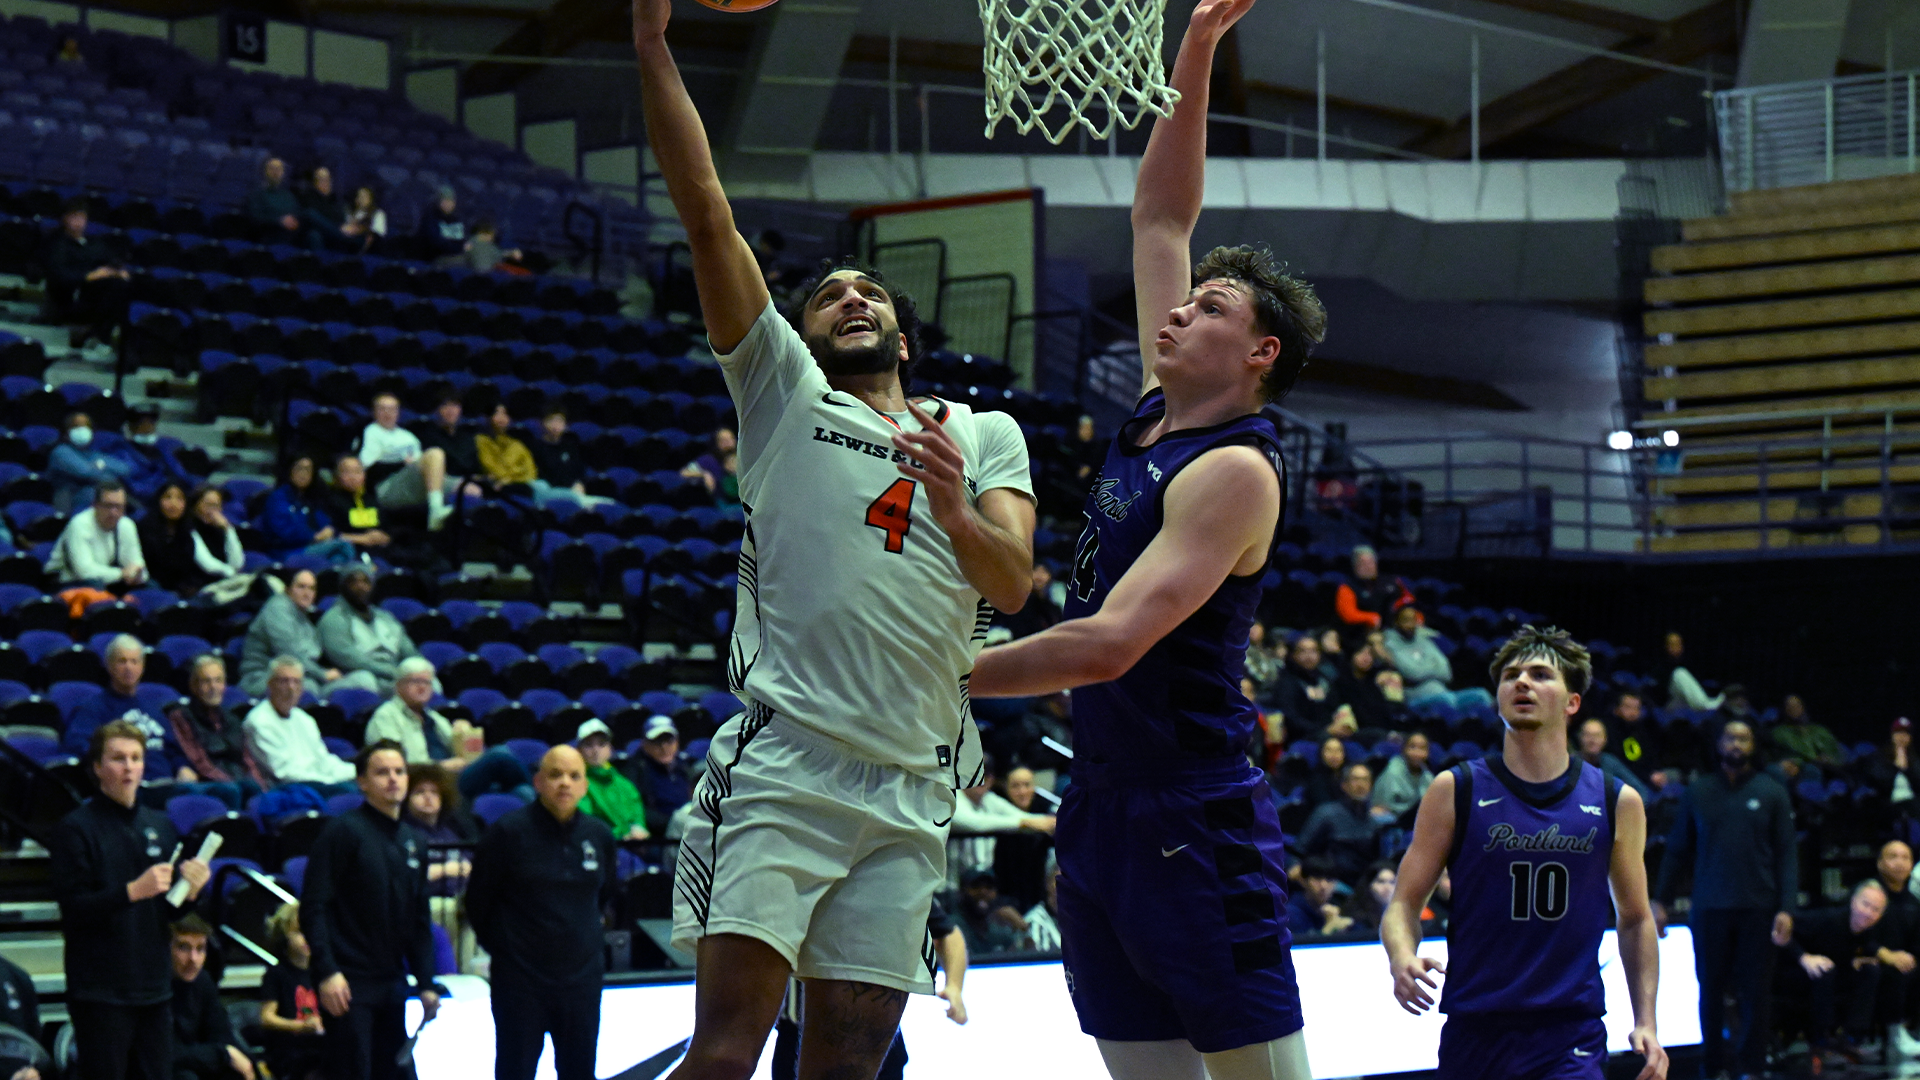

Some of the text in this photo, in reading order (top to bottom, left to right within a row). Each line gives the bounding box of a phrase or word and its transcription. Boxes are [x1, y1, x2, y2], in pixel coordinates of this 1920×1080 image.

[813, 427, 907, 464] LEWIS &
[865, 477, 917, 555] 4
[1483, 823, 1598, 854] Portland
[1509, 861, 1569, 921] 10
